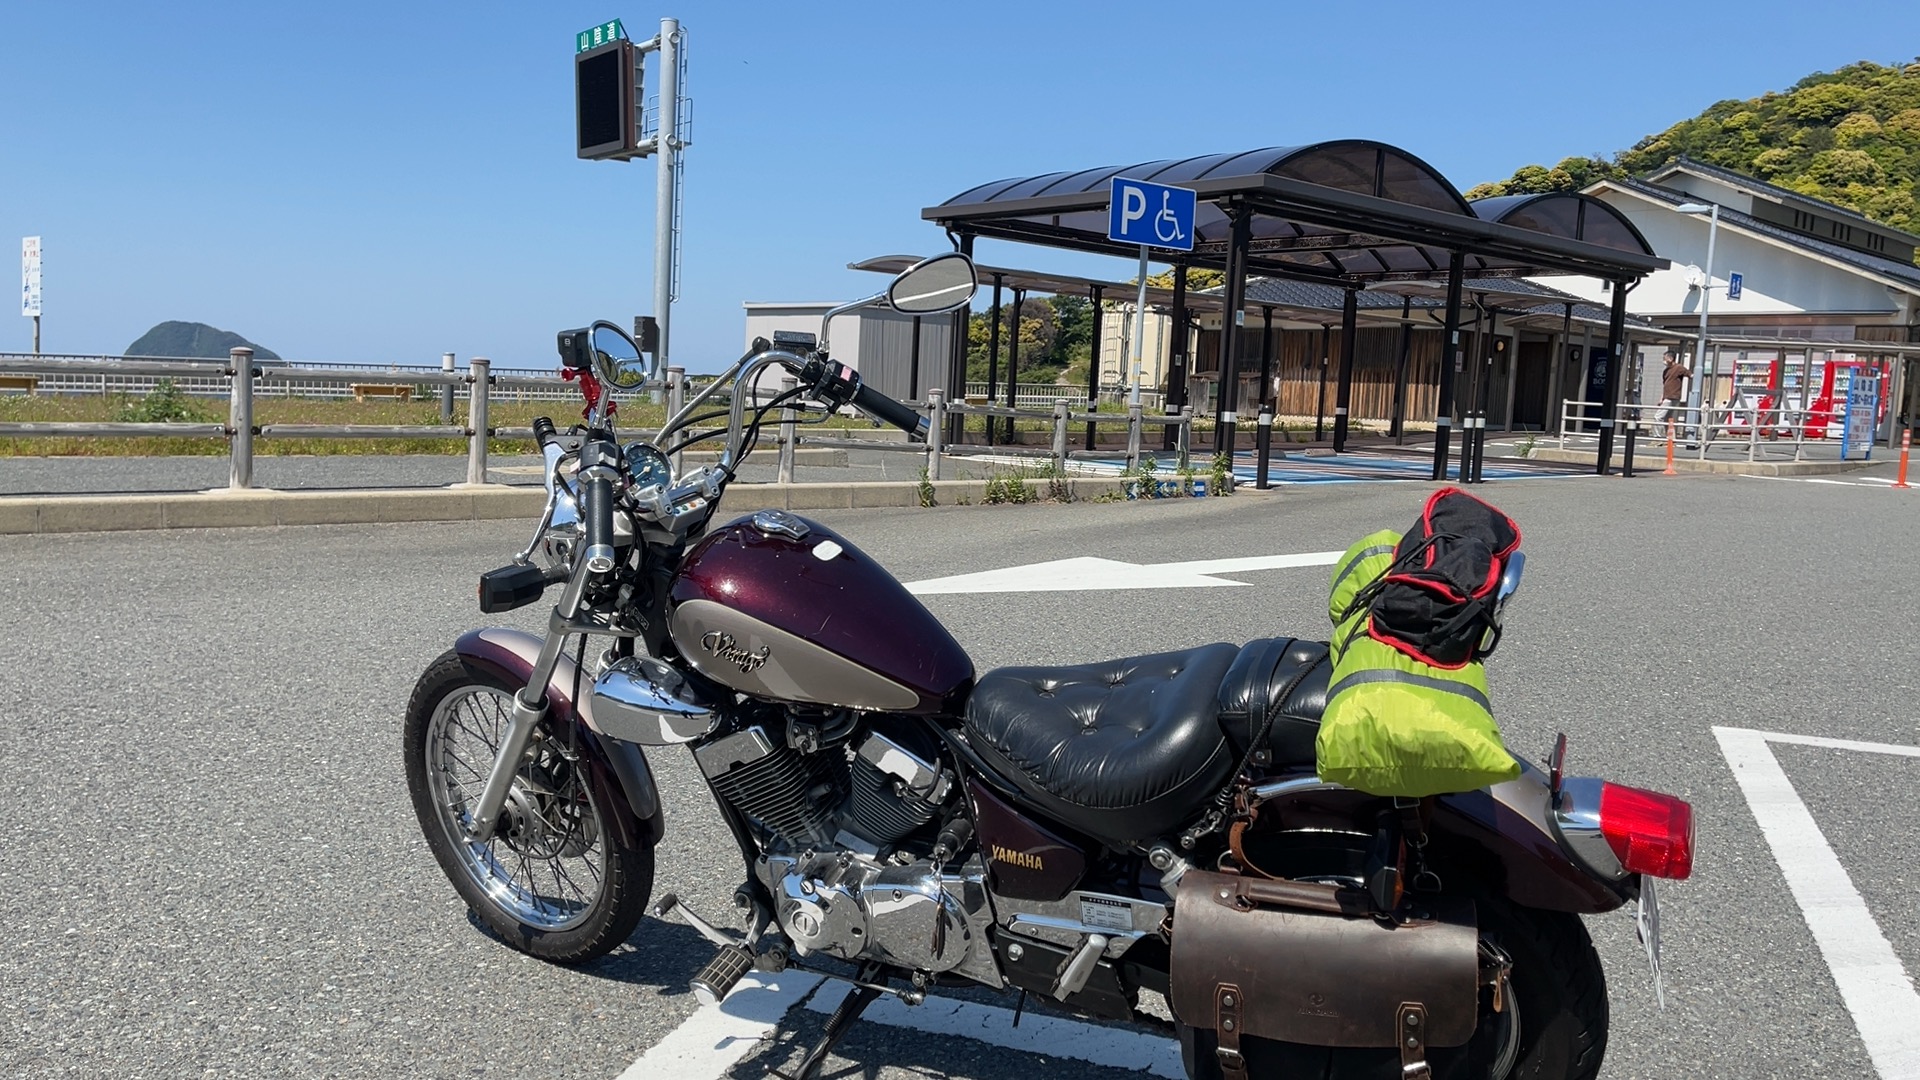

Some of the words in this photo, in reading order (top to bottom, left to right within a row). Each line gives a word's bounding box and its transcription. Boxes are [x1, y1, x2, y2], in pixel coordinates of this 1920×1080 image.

[581, 22, 617, 50] 山陰道
[1121, 185, 1146, 235] P
[700, 631, 770, 673] Virago
[991, 844, 1043, 871] YAMAHA
